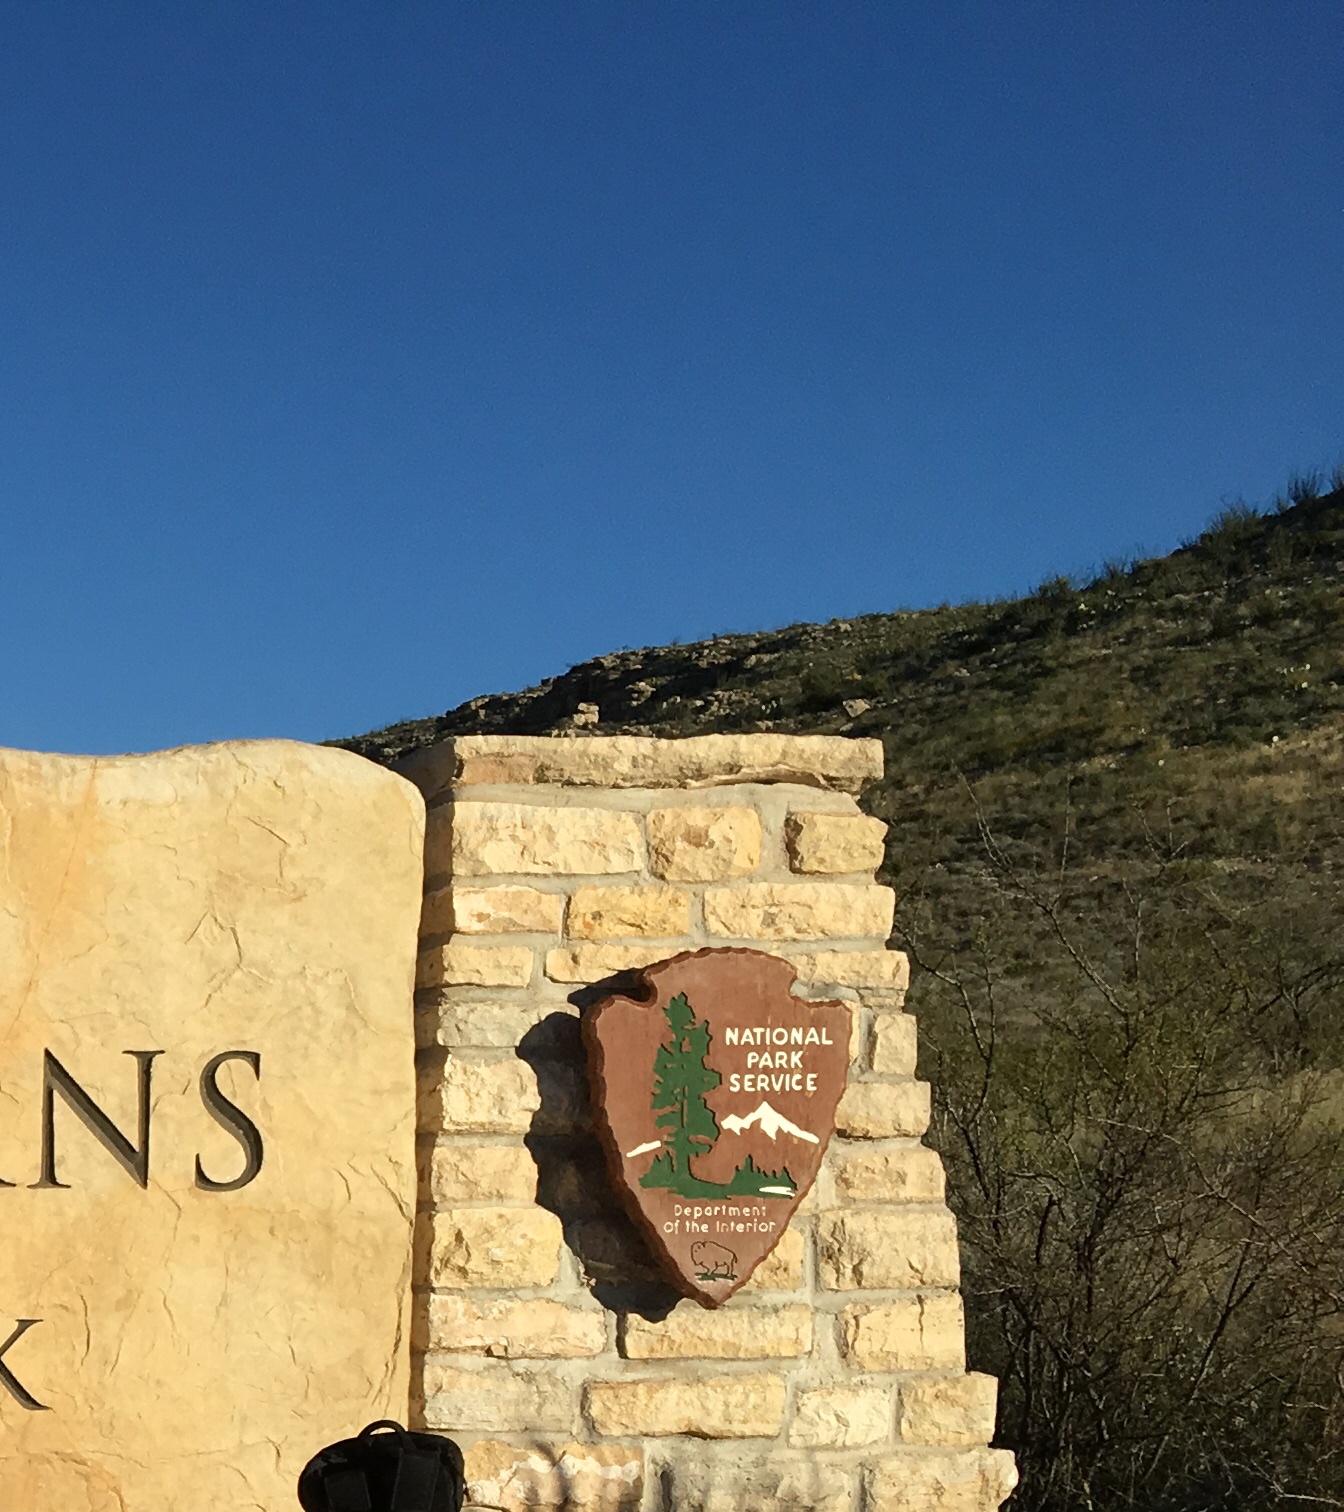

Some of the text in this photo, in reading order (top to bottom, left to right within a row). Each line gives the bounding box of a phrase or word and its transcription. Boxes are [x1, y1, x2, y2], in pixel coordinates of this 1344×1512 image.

[725, 1027, 833, 1046] NATIONAL
[747, 1050, 803, 1069] PARK
[729, 1073, 818, 1092] SERVICE
[674, 1204, 766, 1219] Department
[685, 1220, 709, 1233] the
[716, 1218, 776, 1233] Interior
